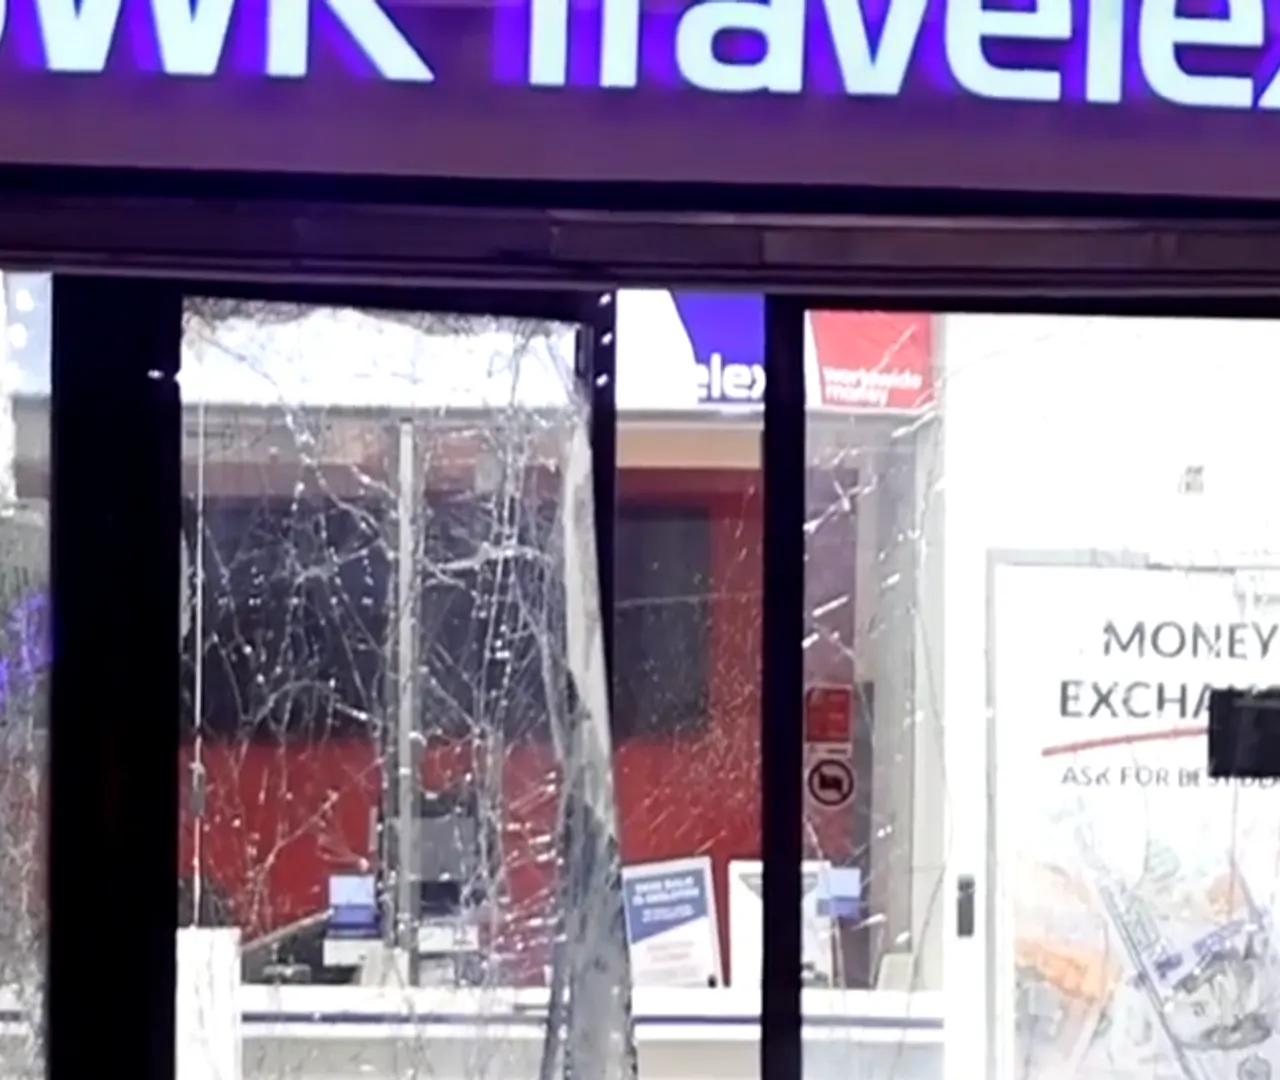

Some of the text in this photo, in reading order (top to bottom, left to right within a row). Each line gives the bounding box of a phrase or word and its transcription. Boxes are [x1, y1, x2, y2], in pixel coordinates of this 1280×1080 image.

[1103, 620, 1279, 659] MONEY
[1060, 766, 1111, 787] ASK
[1120, 766, 1169, 788] FOR
